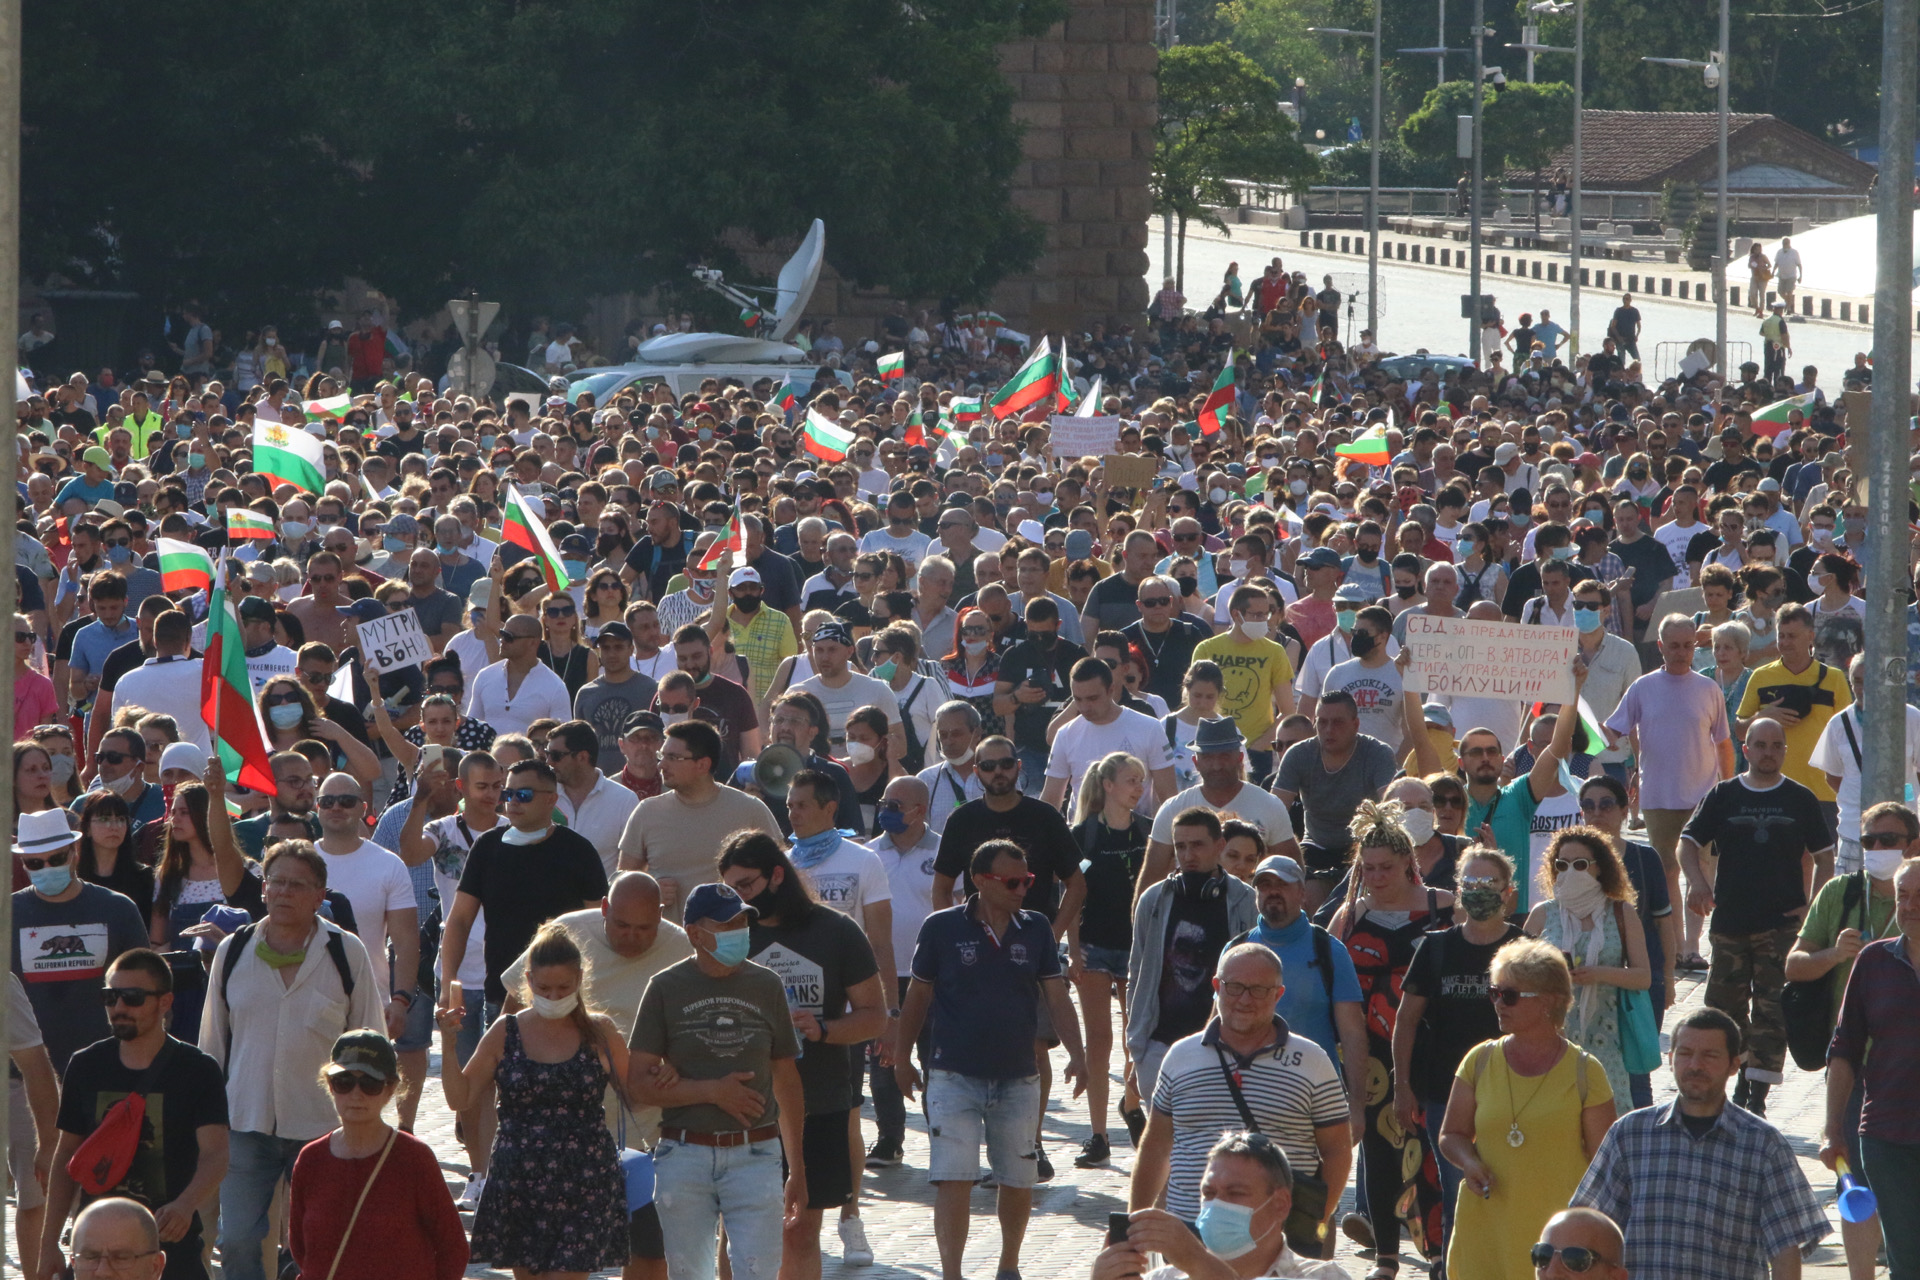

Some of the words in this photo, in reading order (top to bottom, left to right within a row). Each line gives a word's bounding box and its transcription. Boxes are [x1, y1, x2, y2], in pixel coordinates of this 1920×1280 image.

[361, 610, 421, 647] МУТРИ
[1408, 616, 1447, 634] СЪД
[1452, 624, 1466, 636] ЗА
[1471, 625, 1574, 642] ПРЕДАТЕЛИТЕ!!!
[1212, 653, 1269, 669] HAPPY
[1410, 642, 1442, 659] ГЕРБ
[1500, 647, 1569, 666] ЗАТВОРА!
[1407, 661, 1449, 674] СТИГА
[1458, 663, 1557, 680] УПРАВЛЕНСКИ
[1341, 678, 1396, 698] BROOKLYN
[1427, 674, 1542, 697] БОКЛУЦИ!!!
[34, 961, 68, 970] CALIFORNIA
[68, 959, 96, 968] REPUBLIC
[785, 974, 819, 985] INDUSTRY
[1464, 974, 1479, 985] THE
[682, 997, 716, 1014] SUPERIOR
